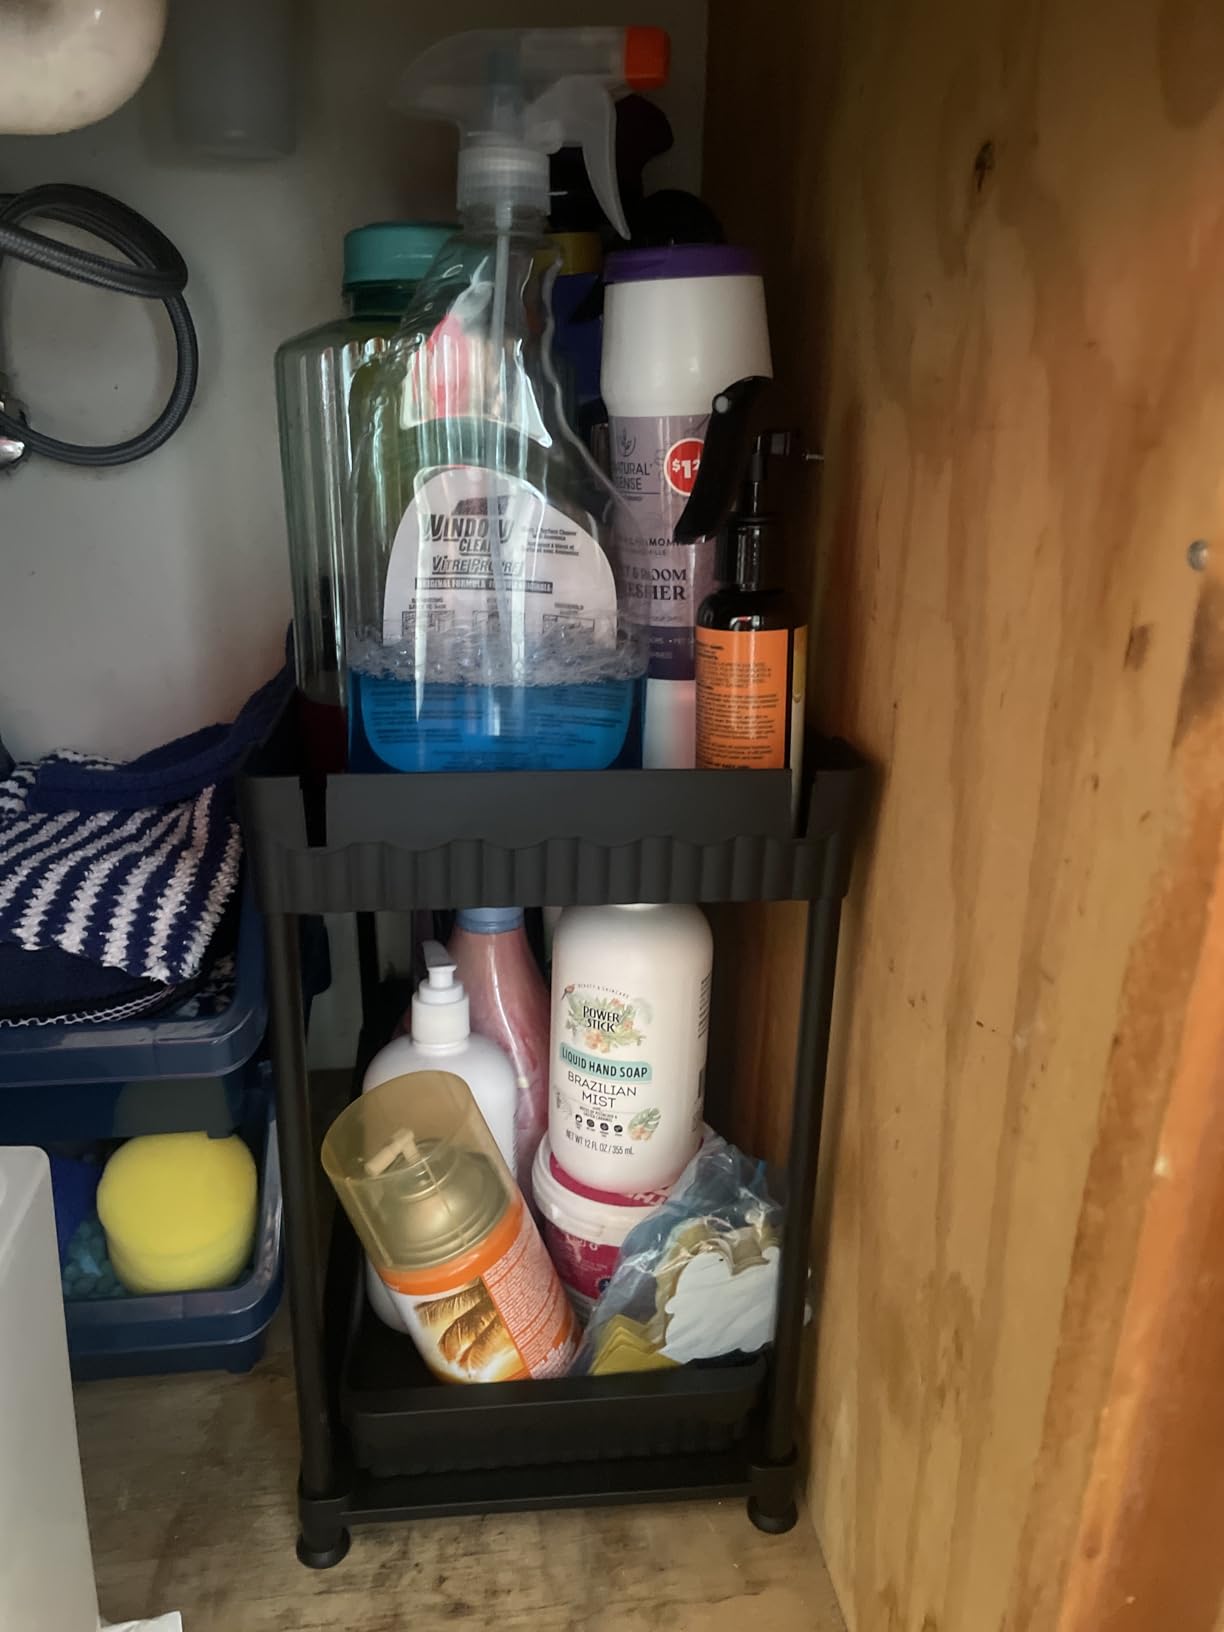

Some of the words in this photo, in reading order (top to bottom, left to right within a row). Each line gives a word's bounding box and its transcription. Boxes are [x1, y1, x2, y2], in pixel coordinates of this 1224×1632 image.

[583, 1005, 620, 1023] POWER
[587, 1018, 616, 1033] STICK
[562, 1047, 587, 1069] LIQUID
[589, 1060, 617, 1077] HAND
[619, 1066, 648, 1079] SOAP
[567, 1070, 637, 1097] BRAZILIAN
[582, 1090, 617, 1109] MIST
[566, 1129, 574, 1141] NET
[575, 1136, 583, 1144] WT
[584, 1139, 591, 1148] 12
[591, 1142, 598, 1151] FL
[600, 1143, 607, 1152] OZ
[612, 1145, 624, 1155] 355
